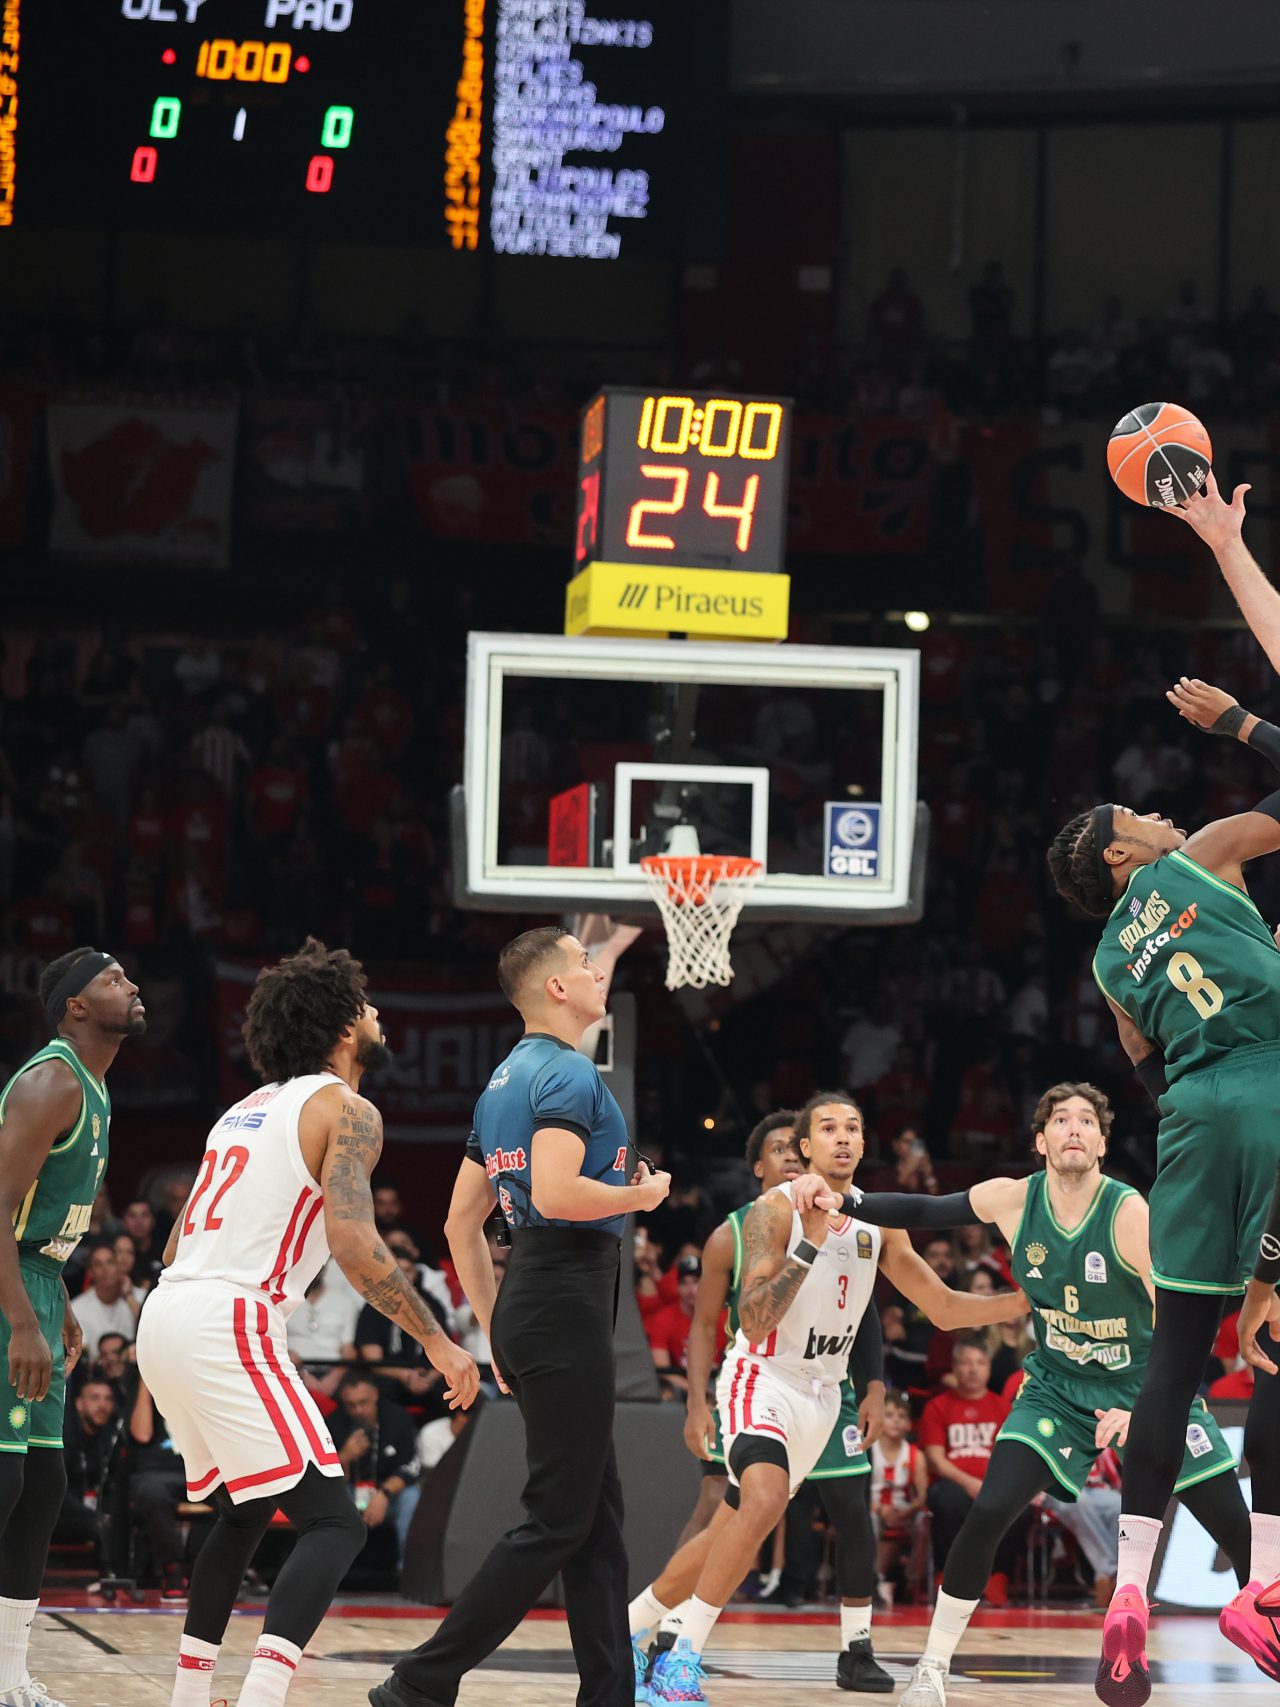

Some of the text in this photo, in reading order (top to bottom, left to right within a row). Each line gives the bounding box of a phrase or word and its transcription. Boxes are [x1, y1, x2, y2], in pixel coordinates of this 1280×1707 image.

[264, 0, 353, 32] PAO
[149, 96, 181, 138] 0
[321, 105, 354, 148] 0
[130, 146, 334, 192] 0 0
[637, 396, 782, 460] 10:00
[626, 464, 760, 552] 24
[655, 584, 764, 617] Piraeus
[831, 856, 875, 876] GBL
[1117, 889, 1171, 954] HOLMES
[1126, 902, 1198, 982] instacar
[1166, 951, 1224, 1020] 8
[182, 1145, 250, 1237] 22
[837, 1275, 848, 1309] 3
[1063, 1285, 1079, 1313] 6
[1087, 1273, 1105, 1281] GBL
[1193, 1443, 1211, 1455] GBL
